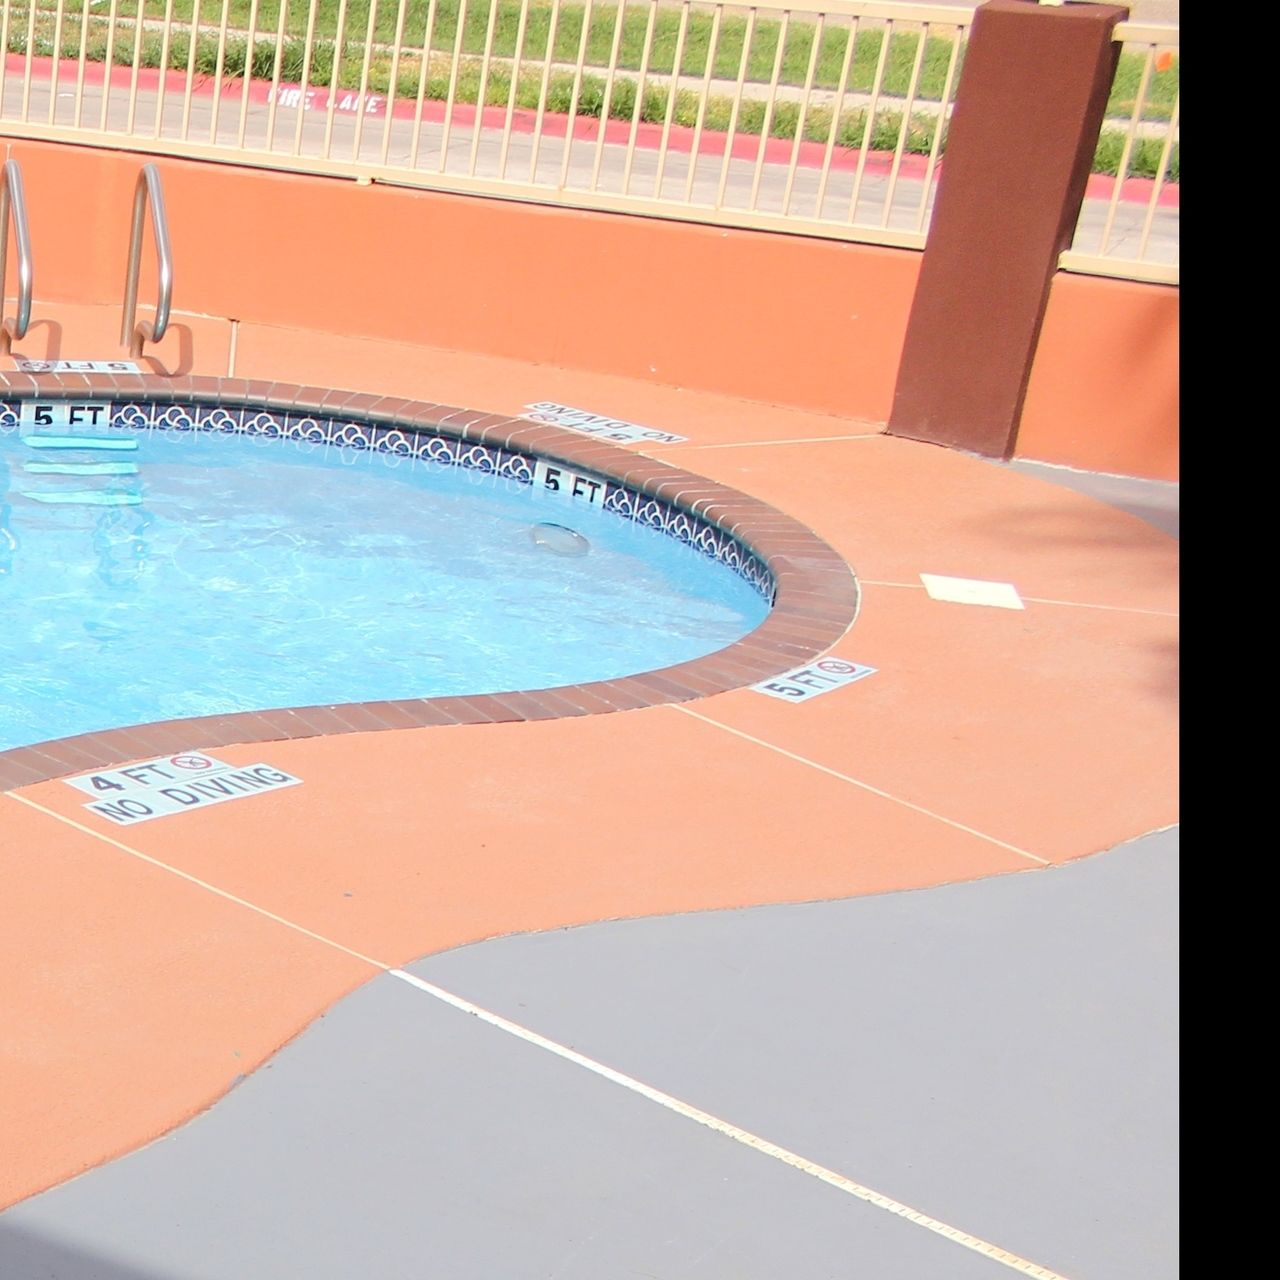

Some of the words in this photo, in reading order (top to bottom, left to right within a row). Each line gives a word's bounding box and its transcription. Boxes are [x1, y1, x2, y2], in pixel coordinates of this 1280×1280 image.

[60, 362, 94, 370] FT
[107, 362, 128, 370] 5
[34, 405, 53, 425] 5
[69, 406, 104, 425] FT
[534, 403, 630, 429] DIVING
[562, 422, 604, 433] FT
[605, 433, 633, 441] 5
[641, 431, 681, 442] NO
[544, 467, 561, 491] 5
[572, 477, 601, 503] FT
[763, 683, 806, 697] 5
[786, 670, 839, 689] FT
[89, 775, 126, 791] 4
[118, 764, 176, 785] FT
[92, 799, 153, 821] NO
[158, 767, 293, 806] DIVING
